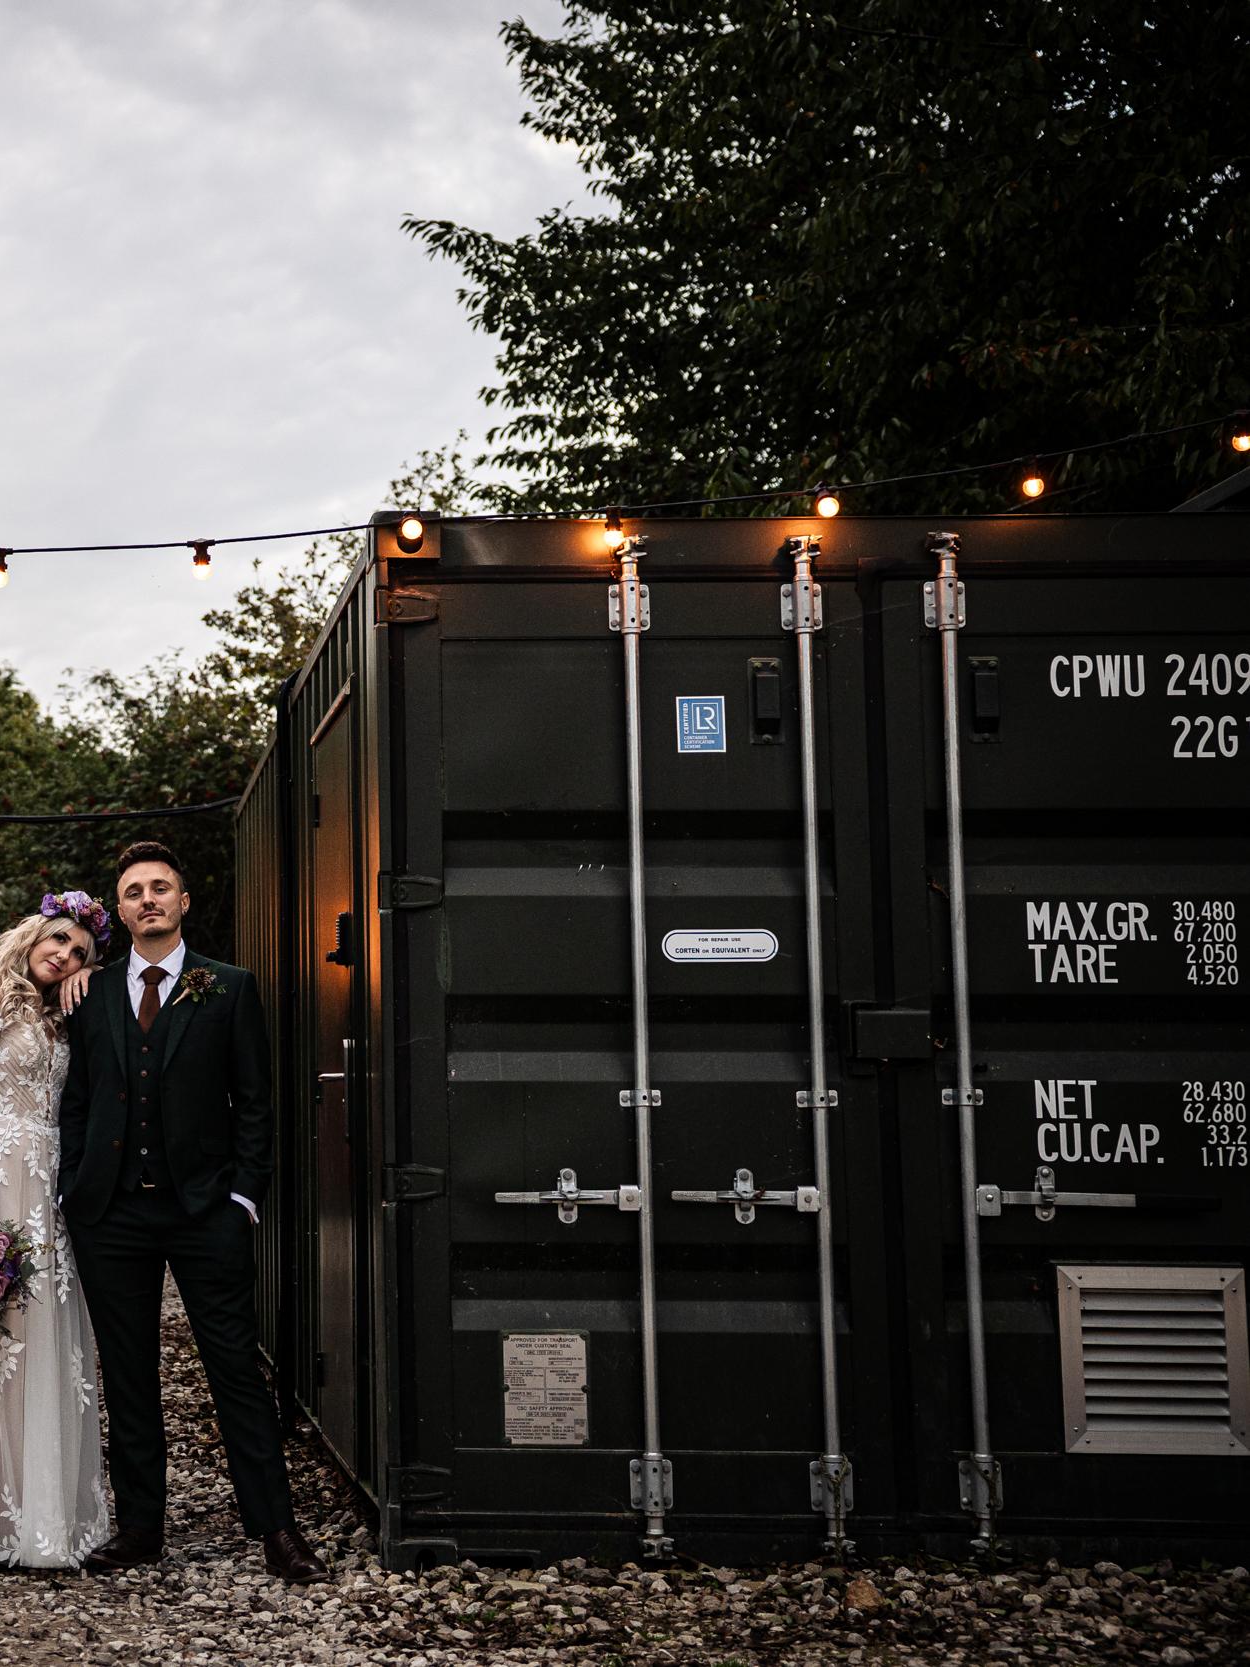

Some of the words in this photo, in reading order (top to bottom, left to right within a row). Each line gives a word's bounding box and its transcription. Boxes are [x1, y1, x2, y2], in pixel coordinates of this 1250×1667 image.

[1050, 655, 1145, 697] CPWU
[1165, 654, 1250, 695] 2409
[1171, 716, 1250, 757] 22G
[1173, 902, 1234, 920] 30,480
[1175, 923, 1236, 942] 67,200
[1187, 944, 1237, 963] 2,050
[1028, 944, 1118, 983] TARE
[1188, 966, 1238, 984] 4,520
[1035, 1080, 1096, 1118] NET
[1183, 1082, 1244, 1101] 28,430
[1184, 1103, 1246, 1122] 62,680
[1208, 1125, 1246, 1144] 33.2
[1202, 1147, 1247, 1166] 1,173
